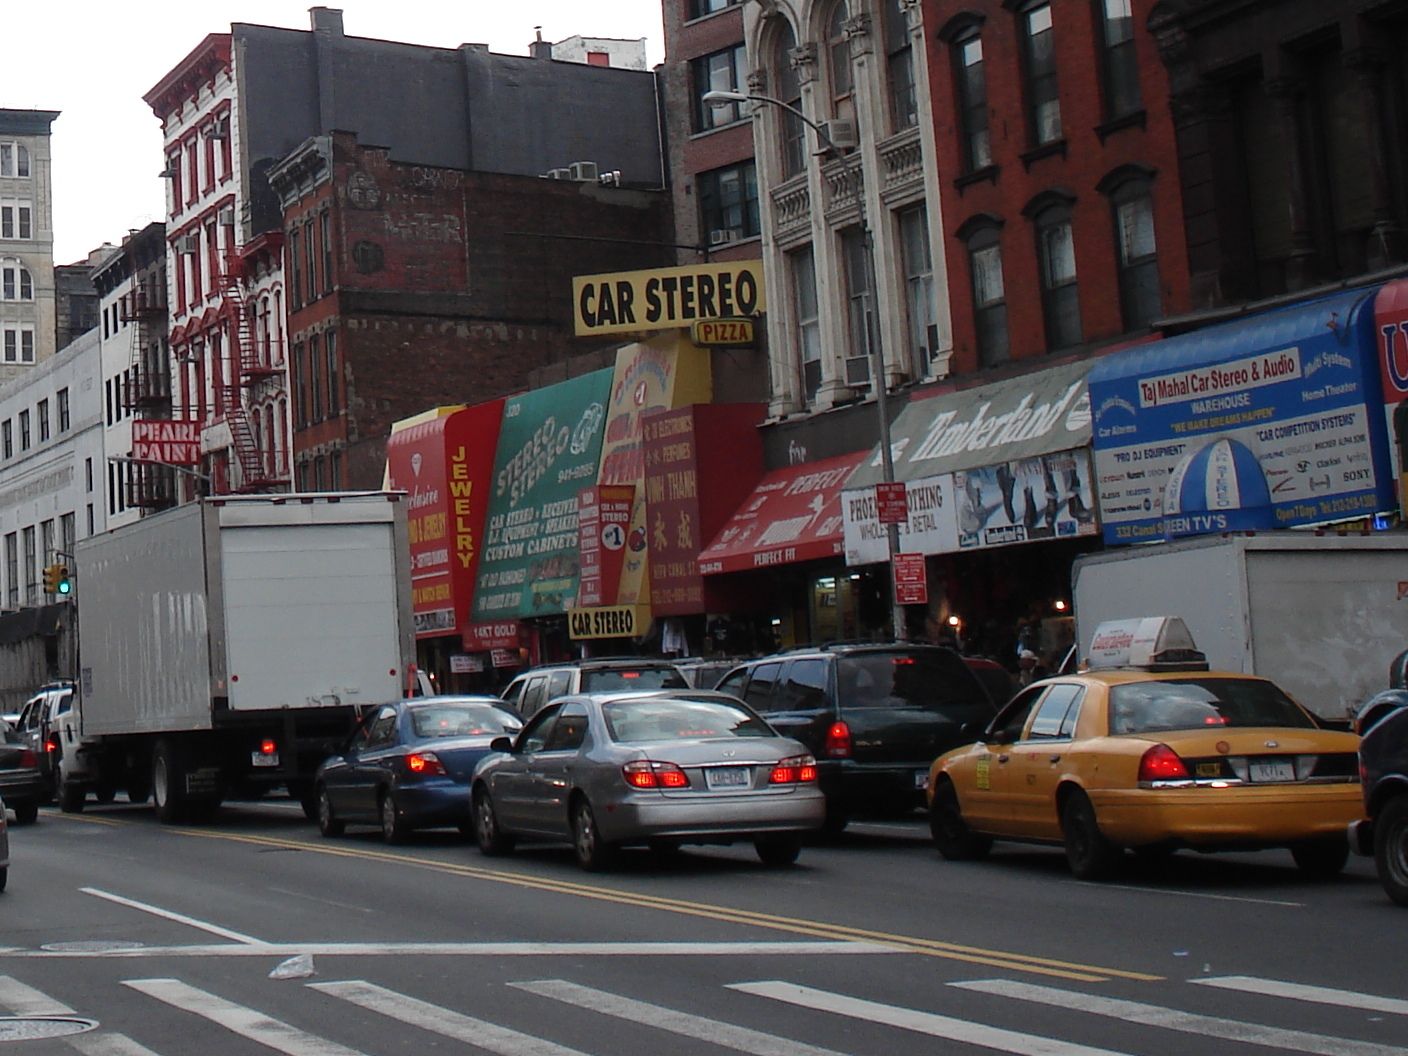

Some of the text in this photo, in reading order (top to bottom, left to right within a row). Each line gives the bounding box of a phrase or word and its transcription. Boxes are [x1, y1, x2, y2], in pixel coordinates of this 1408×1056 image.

[580, 269, 757, 328] CAR STEREO
[702, 323, 748, 341] PIZZA
[1322, 351, 1352, 370] System
[1140, 354, 1295, 405] Taj Mahal Car Stereo & Audio
[1190, 392, 1251, 415] WAREHOUSE
[1301, 385, 1326, 402] Home
[133, 422, 201, 442] PEARL
[909, 379, 1083, 463] Timberland
[1098, 426, 1111, 438] Car
[1256, 412, 1356, 442] "CAR COMPETITION SYSTEMS"
[133, 442, 201, 462] PAINT
[496, 415, 556, 497] STEREO
[1133, 450, 1142, 461] DJ
[509, 425, 570, 508] STEREO
[1342, 468, 1371, 482] SONY
[783, 466, 851, 497] PERFECT
[450, 445, 475, 569] JEWELRY
[850, 484, 943, 523] PHOE OTHING
[490, 514, 505, 530] CAR
[505, 506, 534, 528] STEREO
[600, 512, 629, 523] STEREO
[859, 520, 903, 541] WHOLESE
[912, 514, 938, 534] RETAIL
[1193, 514, 1228, 531] TV'S
[501, 521, 539, 545] EQUIPMENT
[485, 531, 579, 562] CUSTOM CABINETS
[754, 547, 796, 566] PERFECT FIT
[473, 623, 517, 638] 14KT GOLD
[571, 608, 633, 637] CAR STEREO
